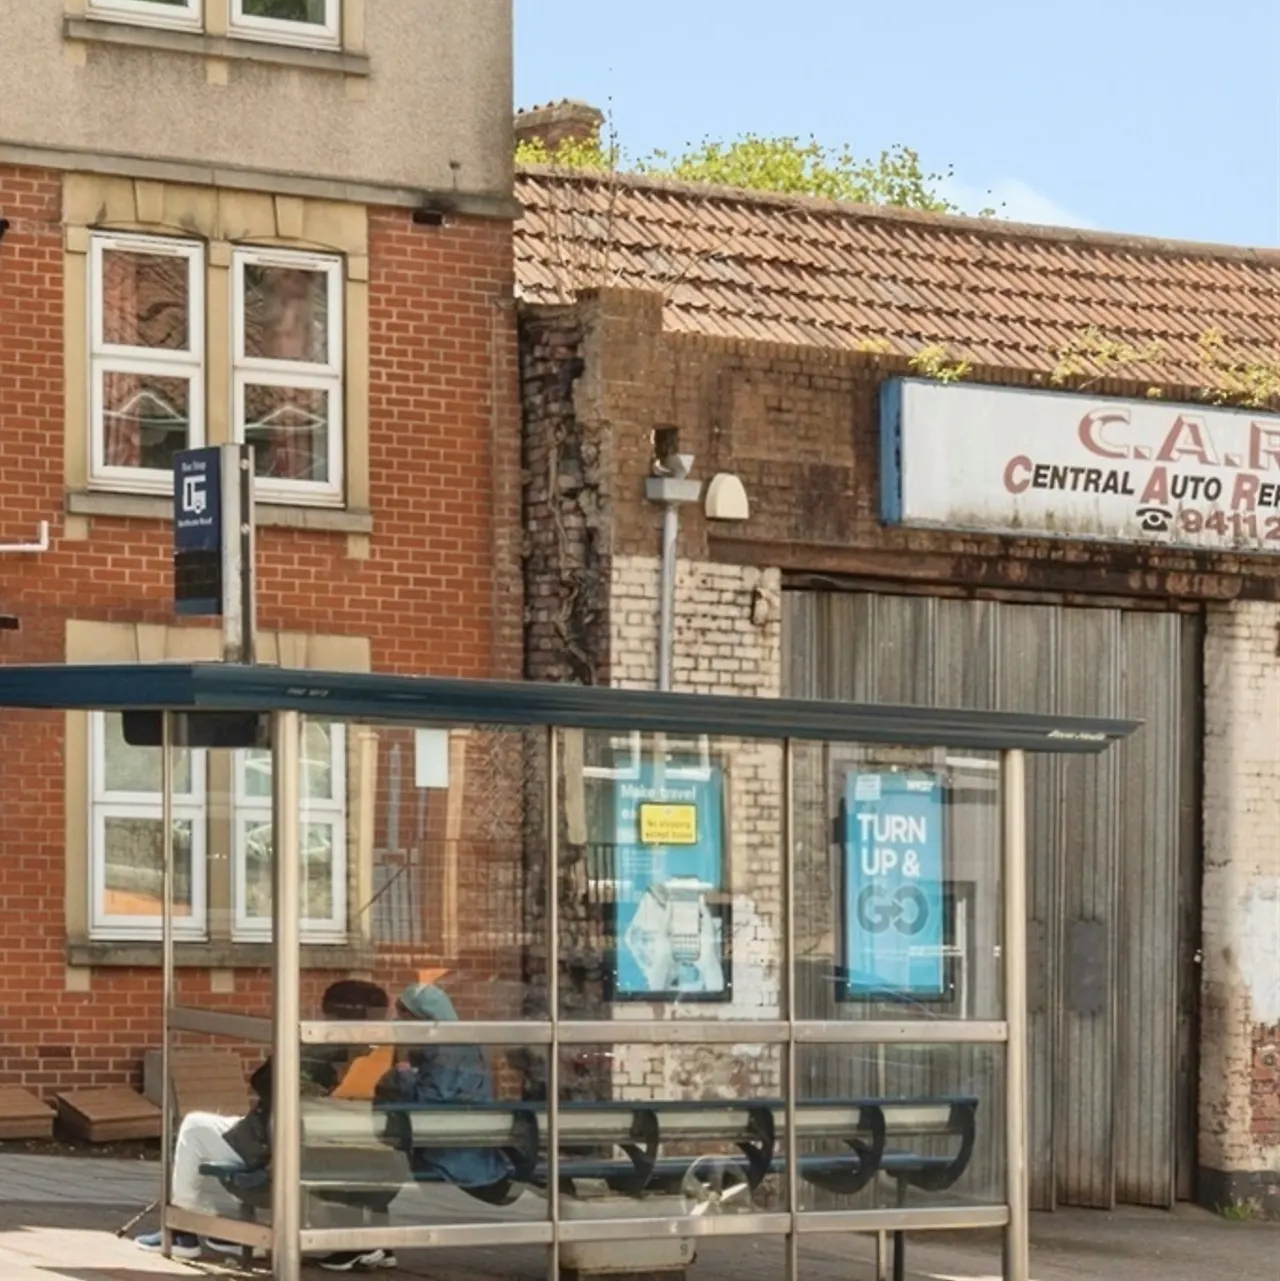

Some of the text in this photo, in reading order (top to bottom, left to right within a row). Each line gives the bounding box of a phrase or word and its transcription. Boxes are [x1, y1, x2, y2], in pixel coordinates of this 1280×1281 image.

[1003, 455, 1135, 494] CENTRAL
[1140, 466, 1222, 504] AUTO
[857, 813, 926, 844] TURN
[861, 847, 921, 877] UP &
